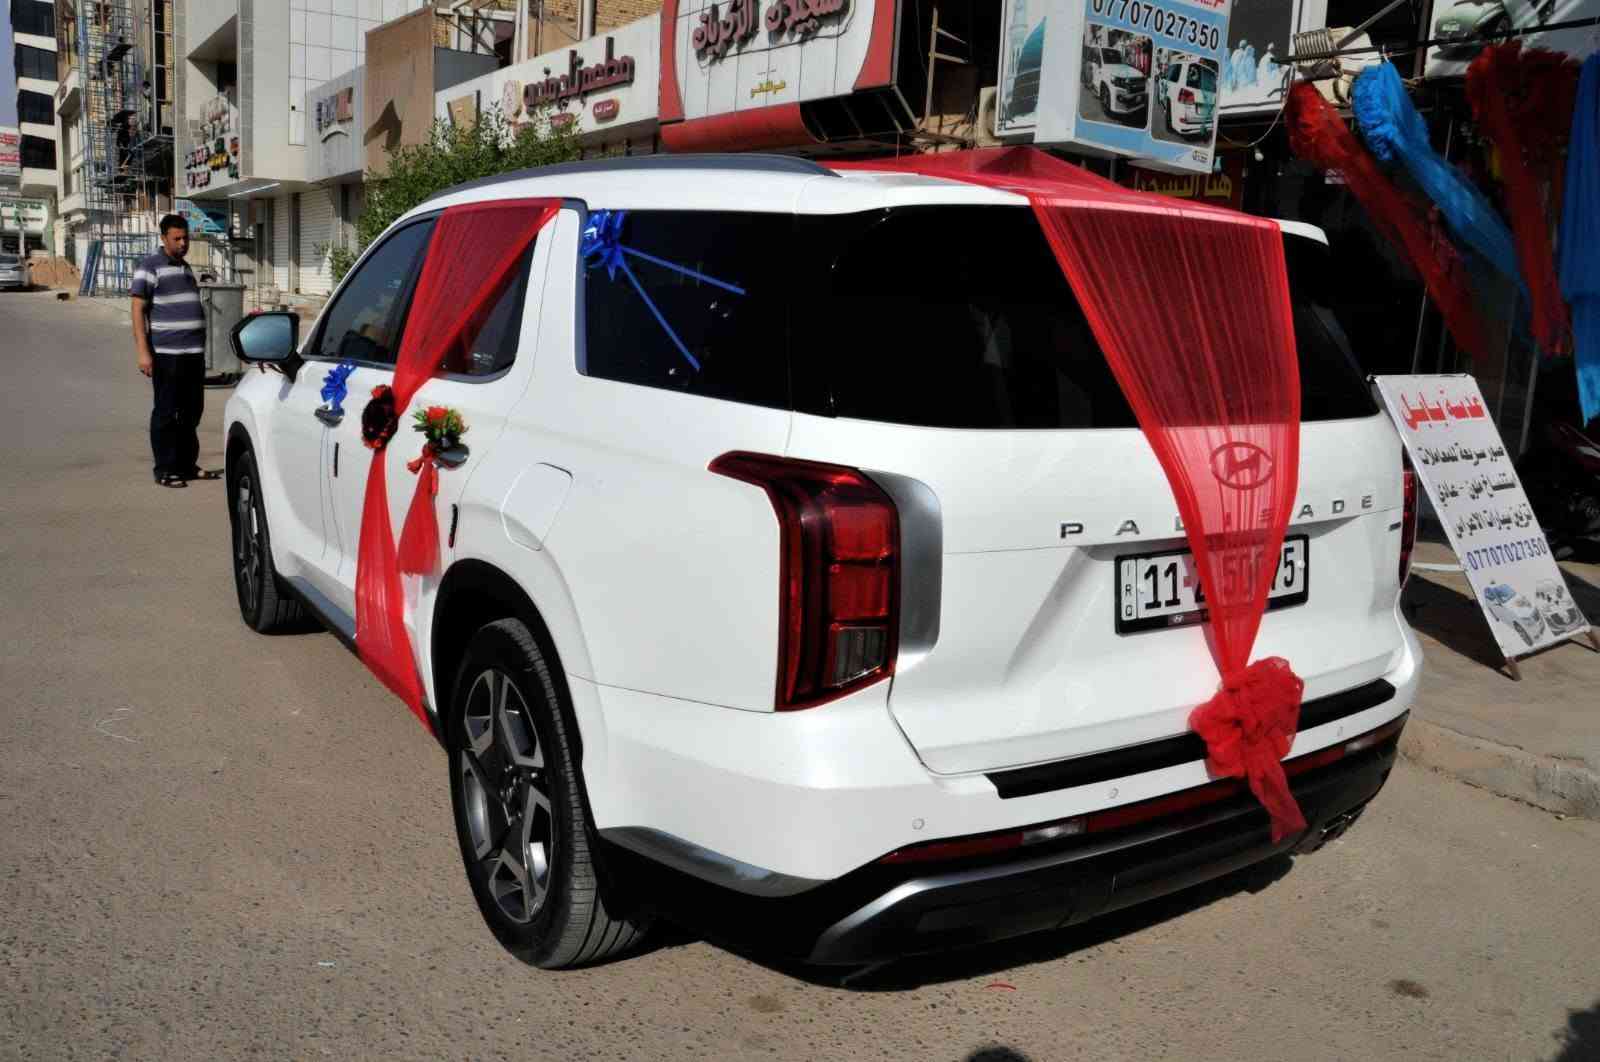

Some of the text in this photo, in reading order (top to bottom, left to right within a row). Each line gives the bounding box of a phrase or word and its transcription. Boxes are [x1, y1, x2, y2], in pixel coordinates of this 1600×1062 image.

[1092, 0, 1220, 50] 07707027350
[580, 36, 636, 106] مطعم
[1400, 389, 1487, 432] عدسة بابل
[1465, 536, 1548, 571] 07707027350
